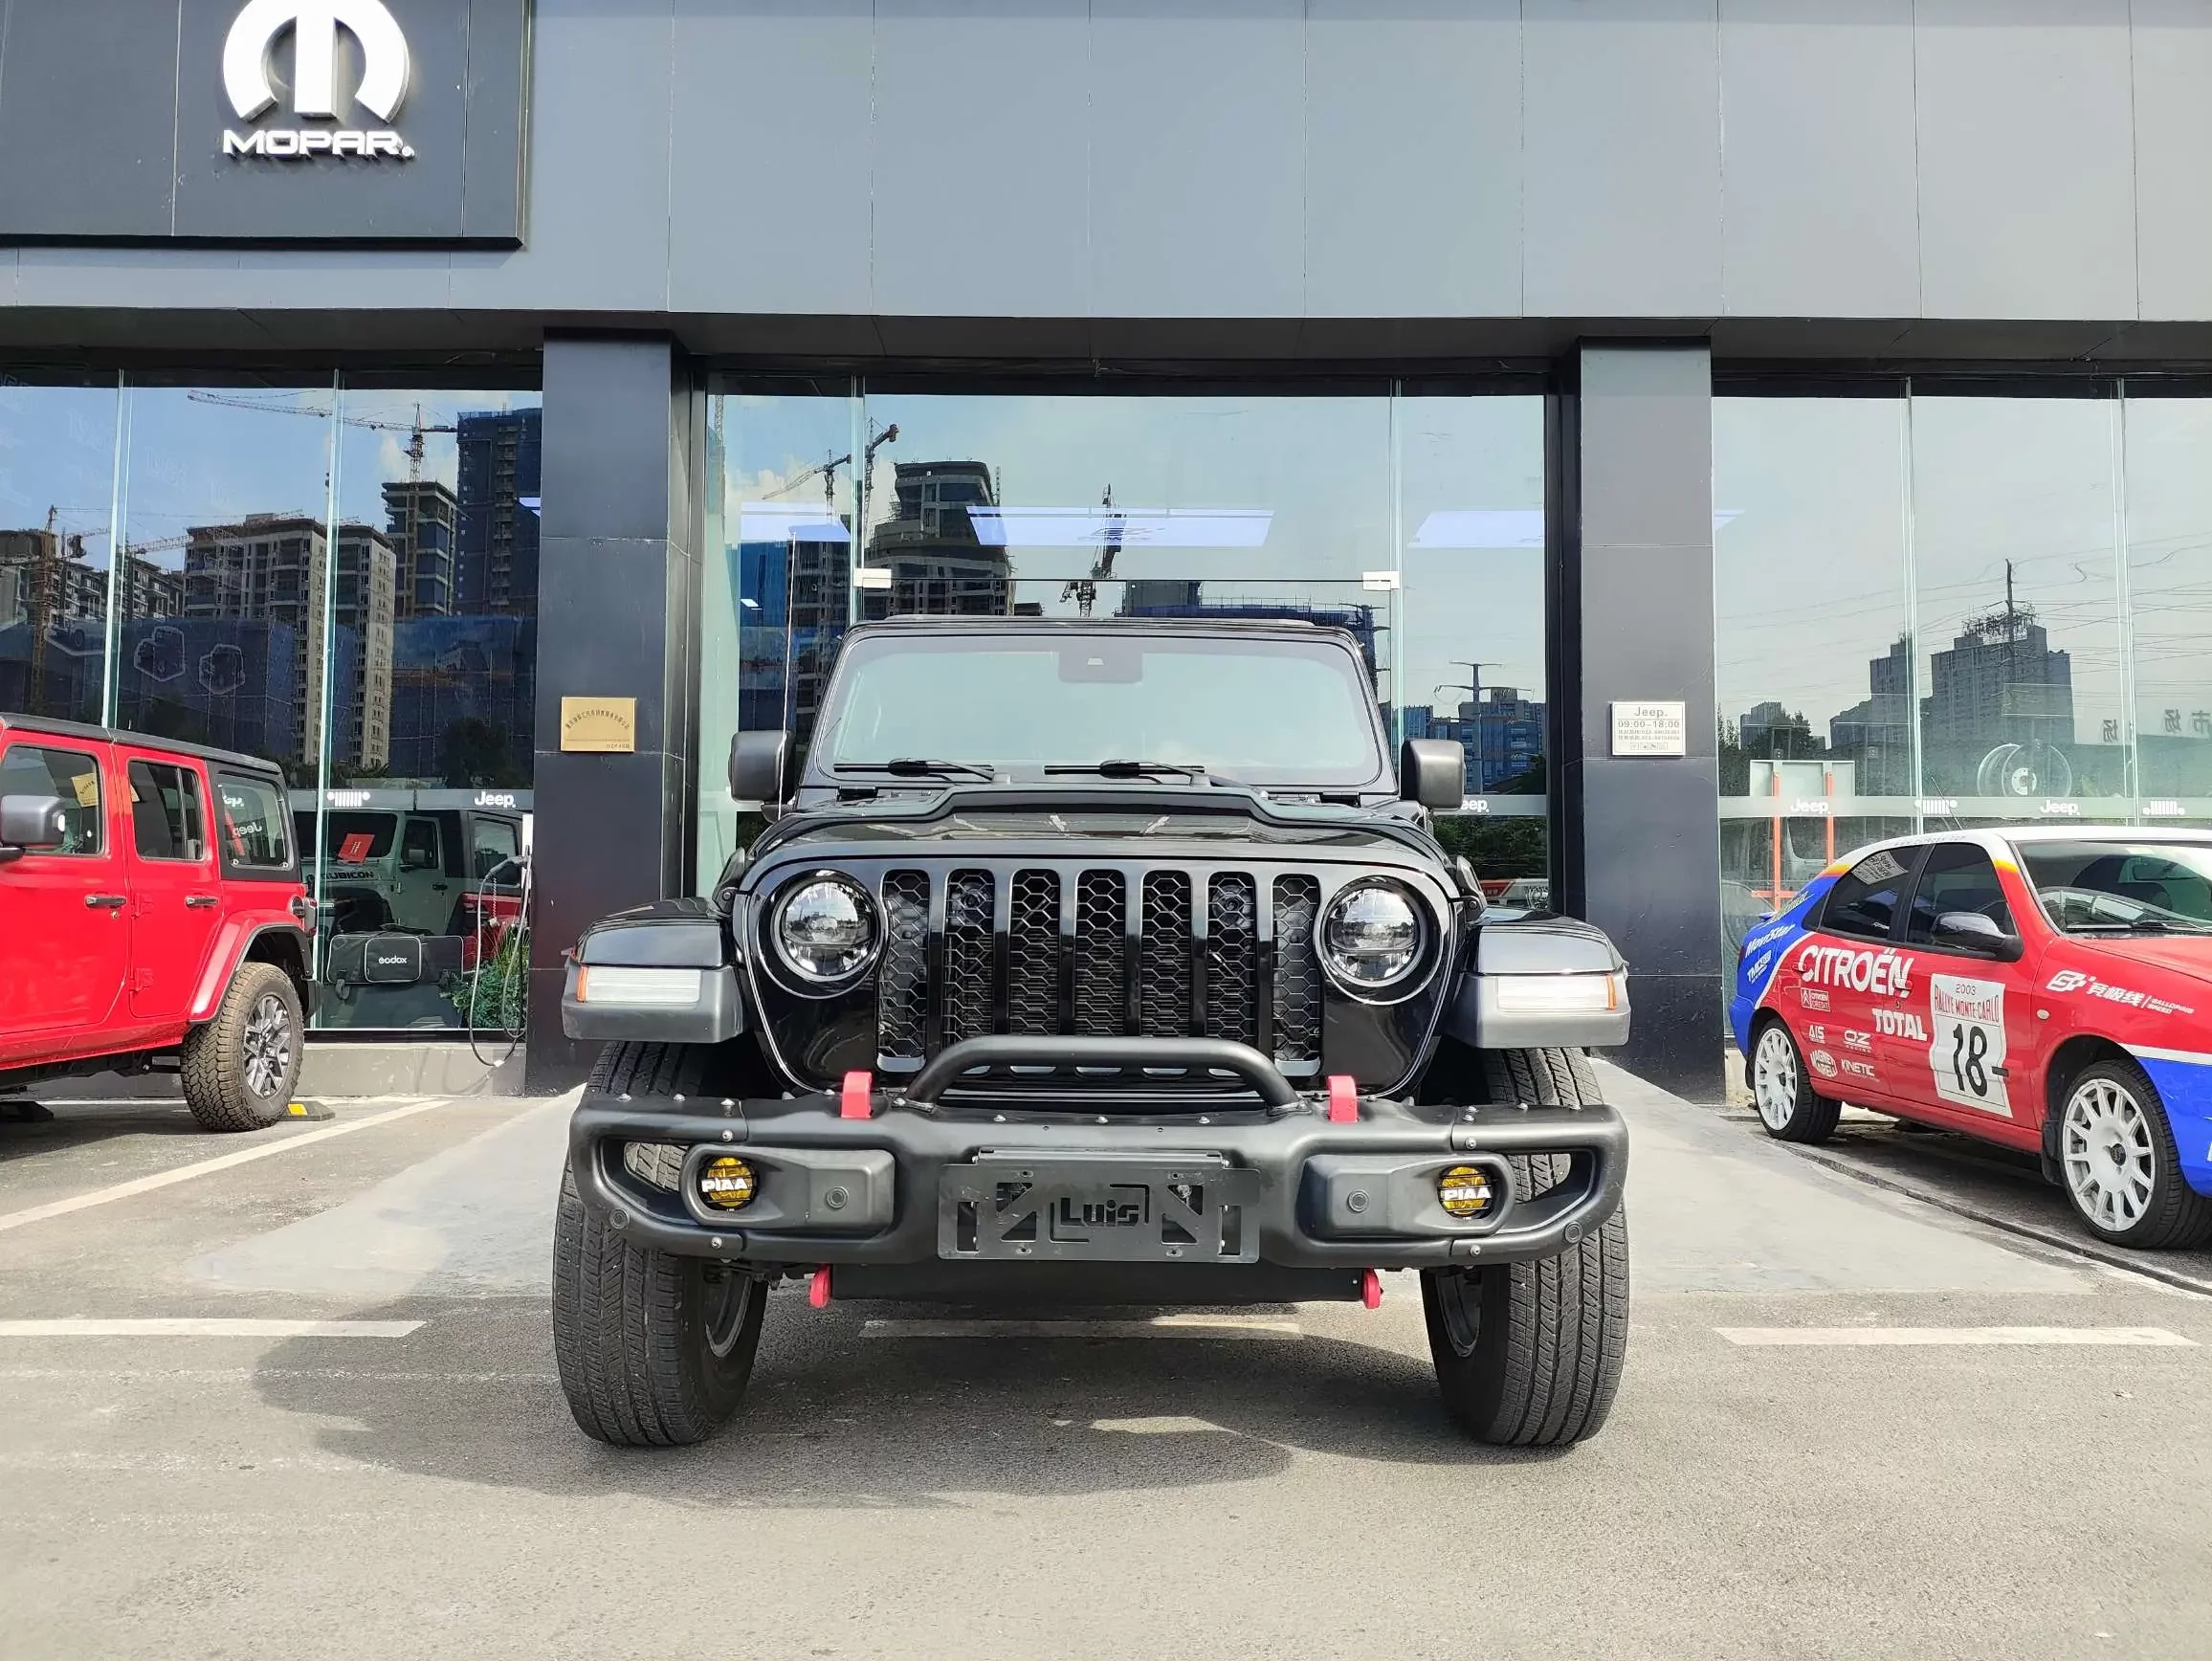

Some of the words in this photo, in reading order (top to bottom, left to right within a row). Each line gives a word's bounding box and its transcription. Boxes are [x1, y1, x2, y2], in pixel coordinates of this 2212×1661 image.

[1956, 983, 1977, 996] 2003
[1935, 985, 1955, 1014] RALLYE
[1872, 1008, 1928, 1042] TOTAL
[1842, 1058, 1875, 1077] KINETIC
[1953, 1023, 1987, 1097] 18
[701, 1178, 747, 1192] PIAA
[1440, 1186, 1492, 1200] PIAA
